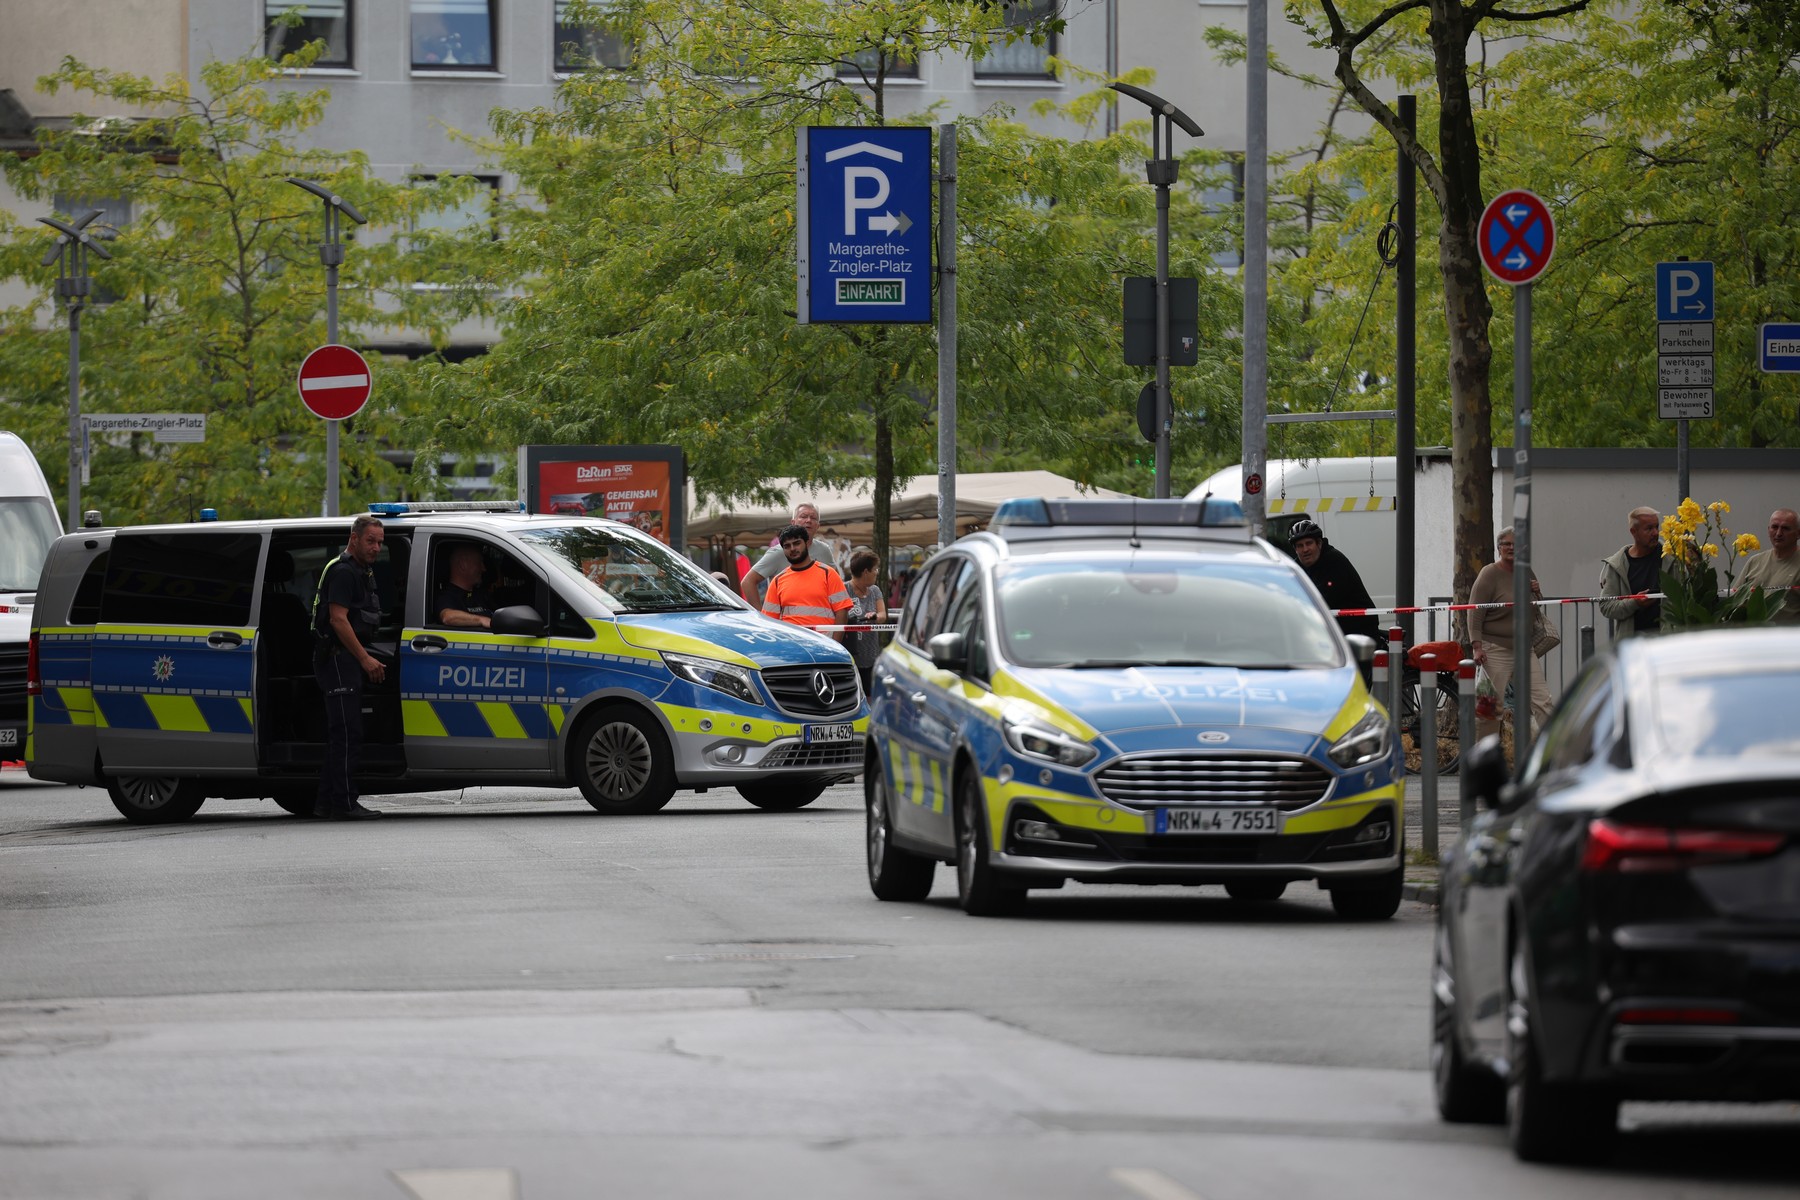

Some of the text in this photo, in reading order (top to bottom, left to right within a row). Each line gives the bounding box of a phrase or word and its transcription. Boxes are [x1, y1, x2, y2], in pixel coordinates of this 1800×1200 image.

[845, 166, 890, 235] P
[829, 242, 909, 258] Margarethe-
[829, 260, 912, 275] Zingler-Platz
[839, 285, 900, 299] EINFAHRT
[1670, 270, 1700, 314] P
[1679, 328, 1693, 337] mit
[1662, 338, 1710, 347] Parkschein
[1665, 358, 1705, 368] werktags
[1684, 368, 1690, 376] 8
[1660, 376, 1670, 384] Sa
[1684, 376, 1690, 384] 8
[1664, 391, 1708, 400] Bewohner
[1703, 401, 1710, 415] S
[606, 489, 658, 500] GEMEINSAM
[606, 502, 635, 511] AKTIV
[439, 665, 526, 688] POLIZEI
[1110, 685, 1288, 702] POLIZEI
[811, 726, 825, 741] NRW
[1167, 811, 1201, 830] NRW
